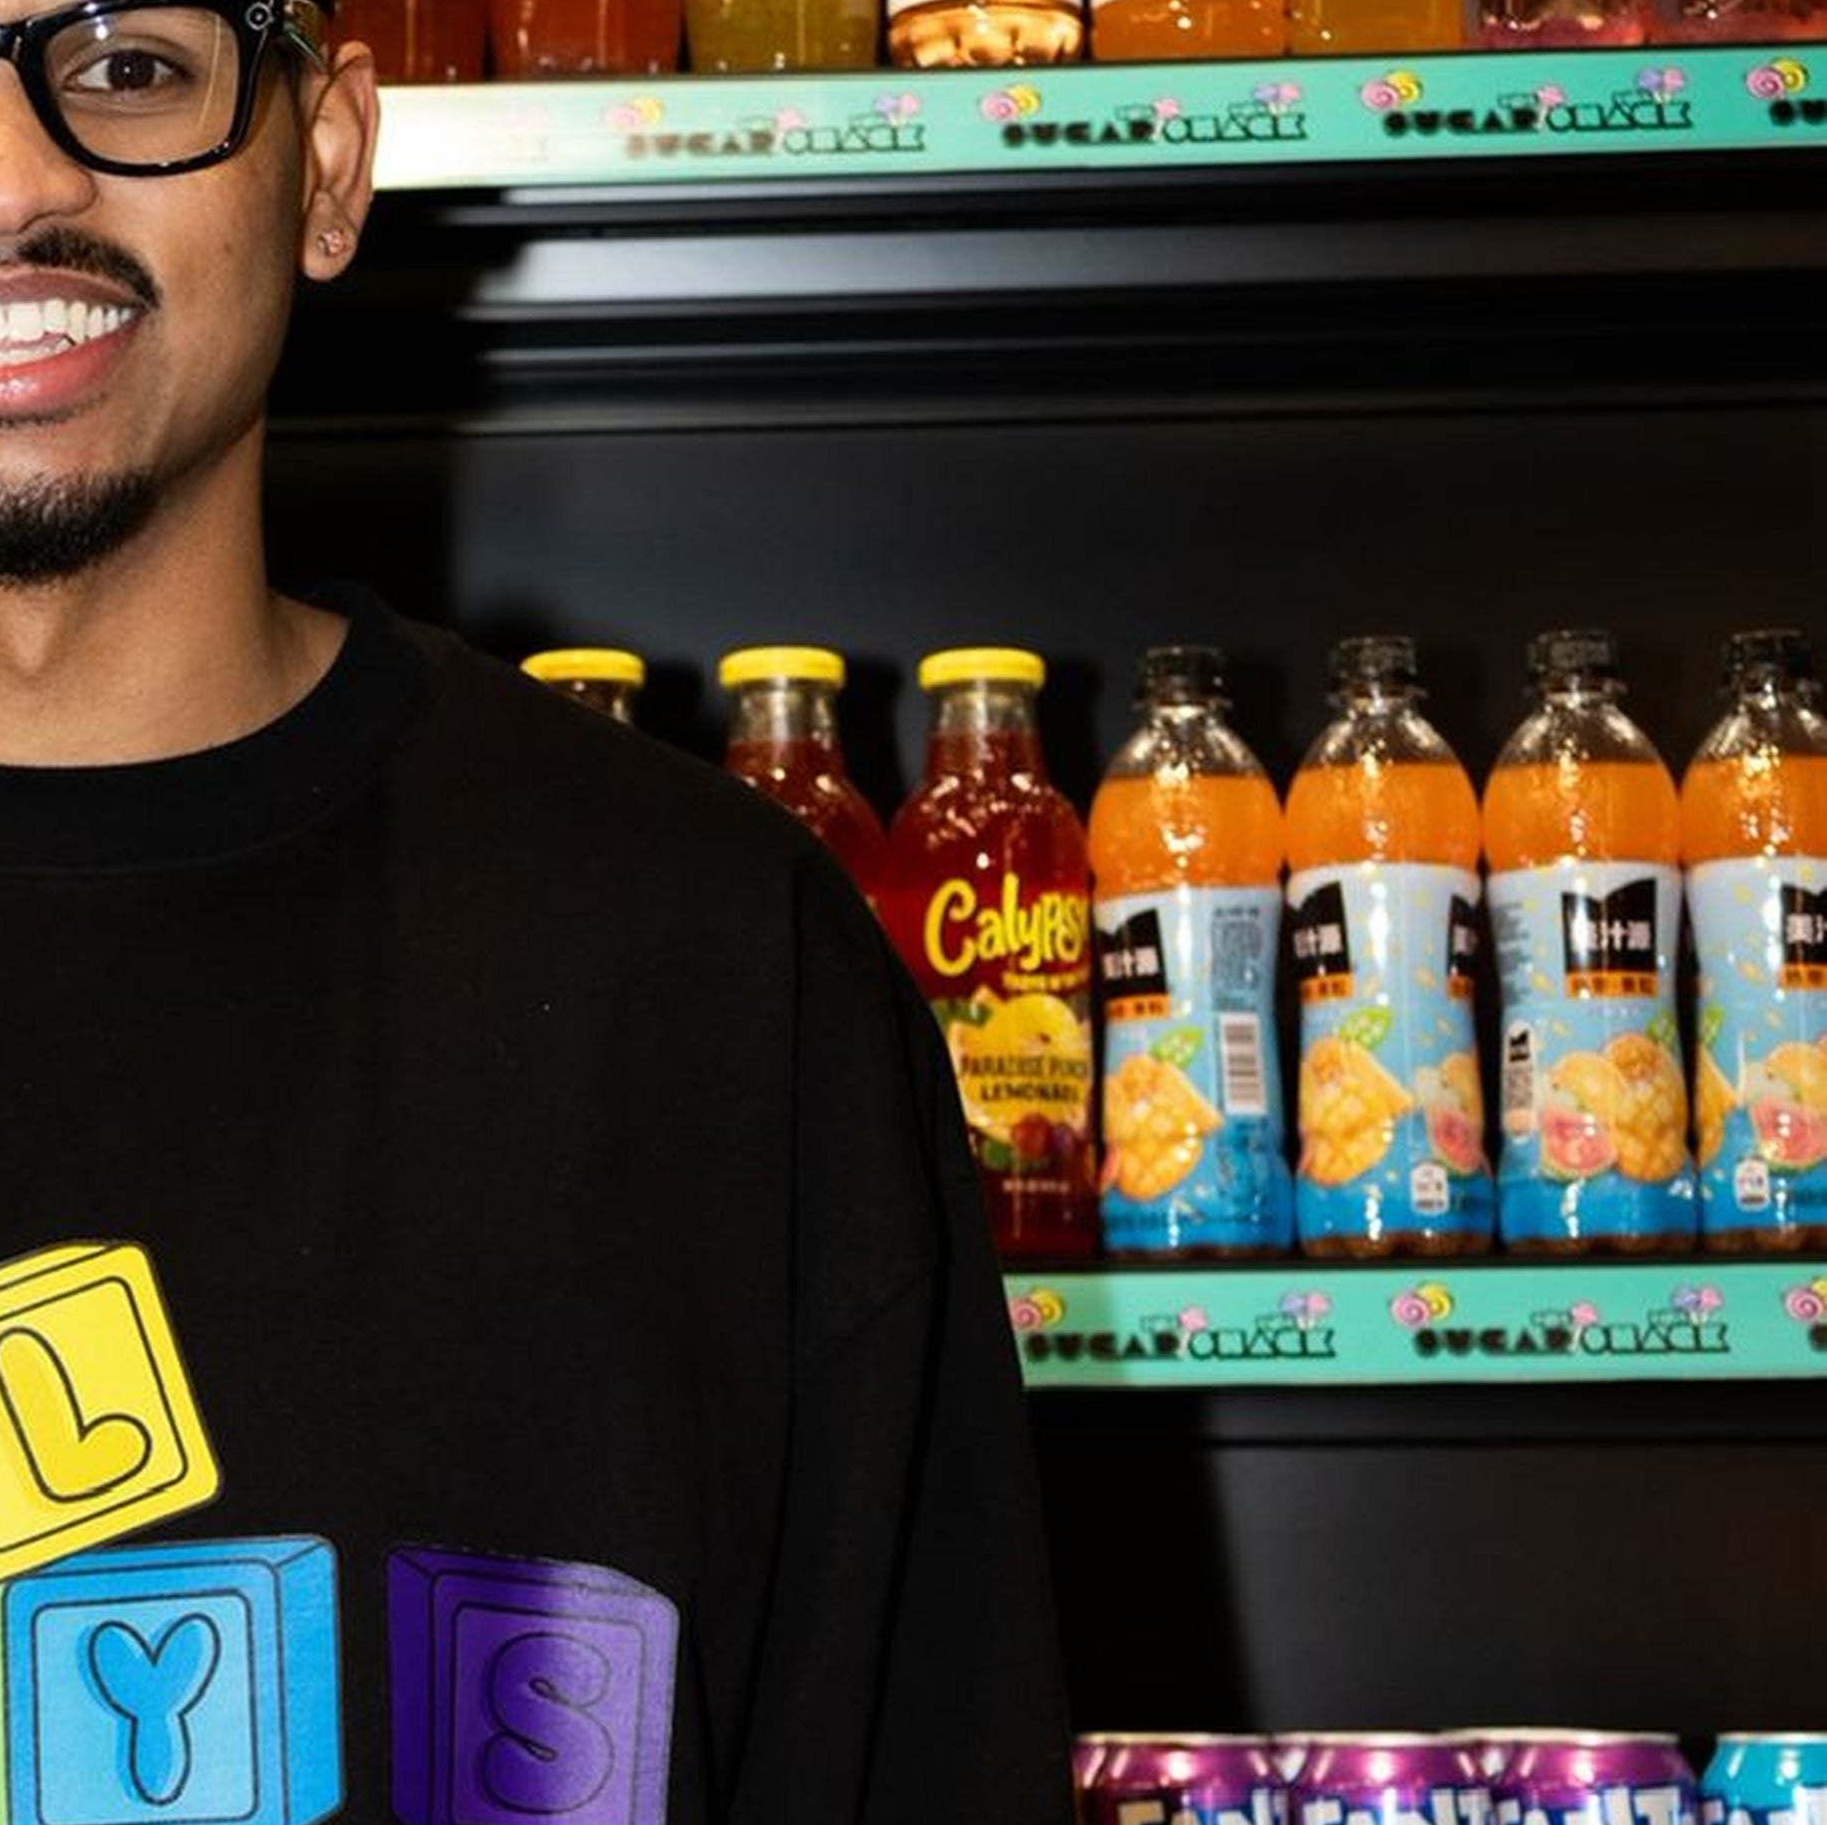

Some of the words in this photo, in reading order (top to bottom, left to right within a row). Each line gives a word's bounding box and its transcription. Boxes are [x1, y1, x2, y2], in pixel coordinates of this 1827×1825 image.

[1000, 121, 1154, 149] SUGAR
[1383, 108, 1538, 138] SUGAR
[1025, 1331, 1178, 1362] SUGAR
[1413, 1329, 1572, 1358] SUGAR
